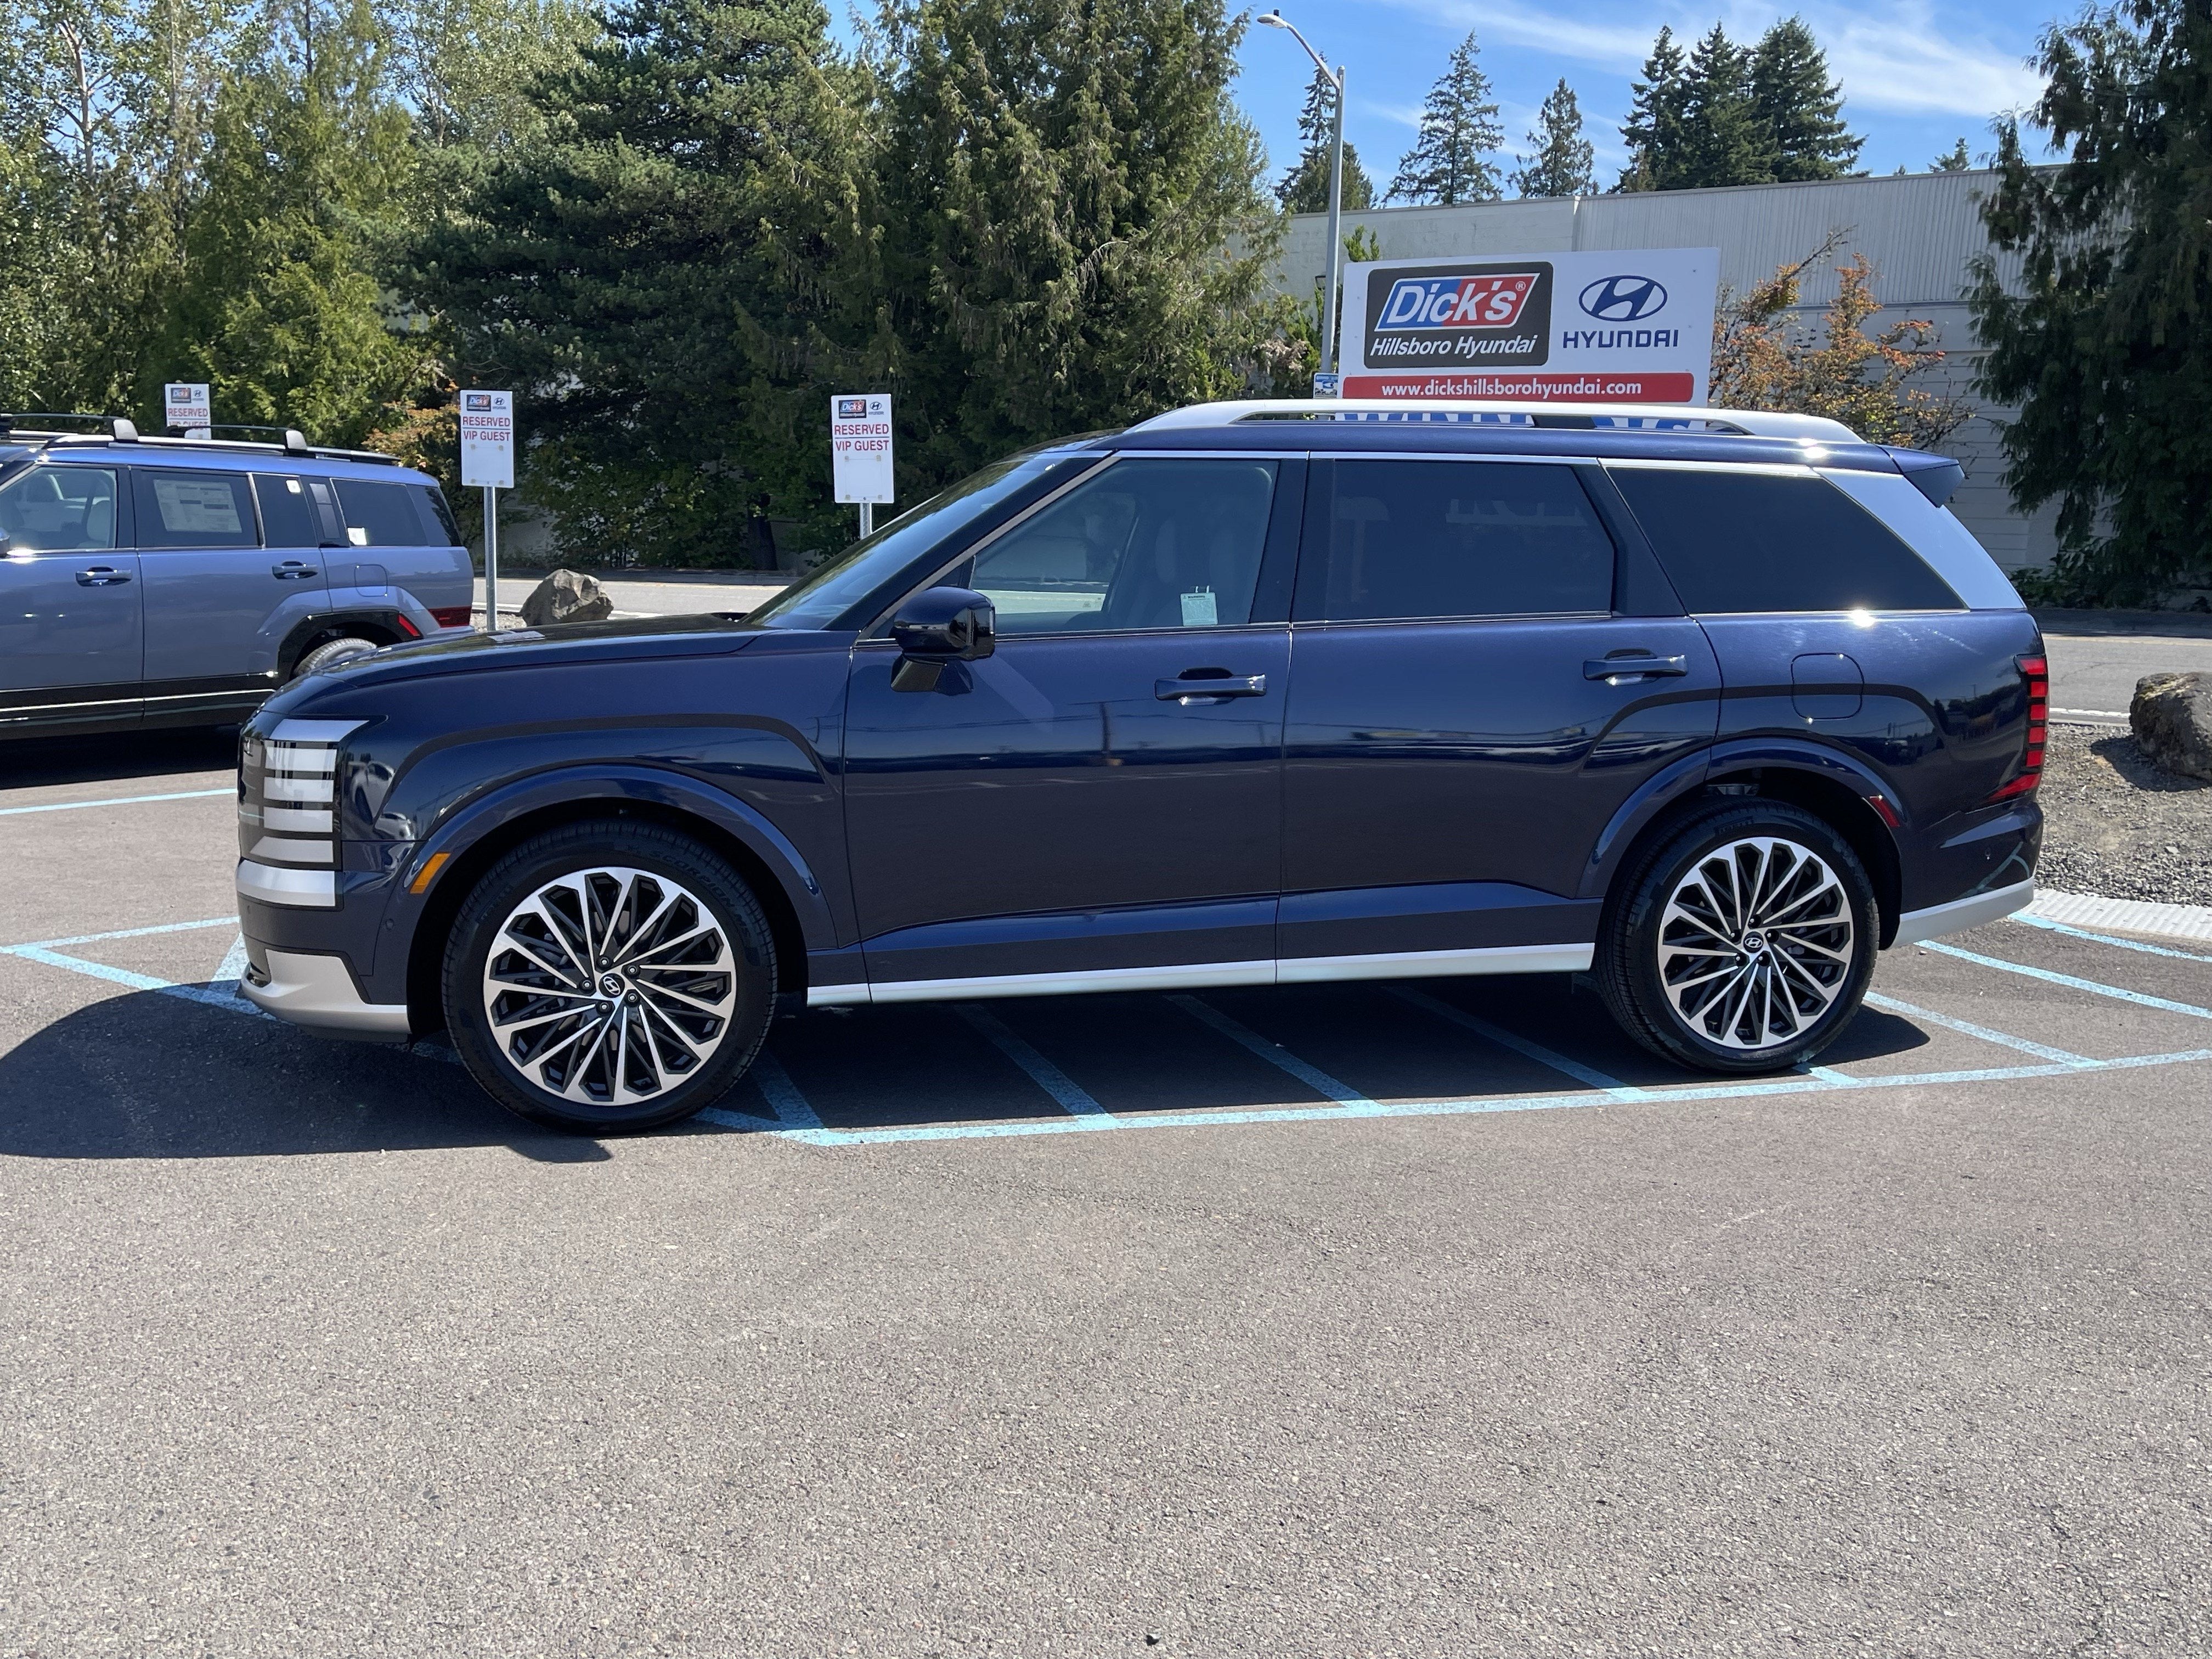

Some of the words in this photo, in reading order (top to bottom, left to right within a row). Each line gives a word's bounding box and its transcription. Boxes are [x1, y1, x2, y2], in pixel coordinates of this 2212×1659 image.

[1386, 280, 1517, 324] Dick's
[1562, 329, 1679, 349] HYUNDAI
[1369, 337, 1452, 357] Hillsboro
[1454, 335, 1538, 359] Hyundai
[1381, 377, 1643, 399] www.dickshillsborohyundai.com
[167, 408, 208, 417] RESERVED
[462, 416, 510, 427] RESERVED
[834, 424, 889, 435] RESERVED
[463, 430, 477, 440] VIP
[480, 431, 511, 441] GUEST
[835, 441, 851, 451] VIP
[854, 440, 889, 451] GUEST
